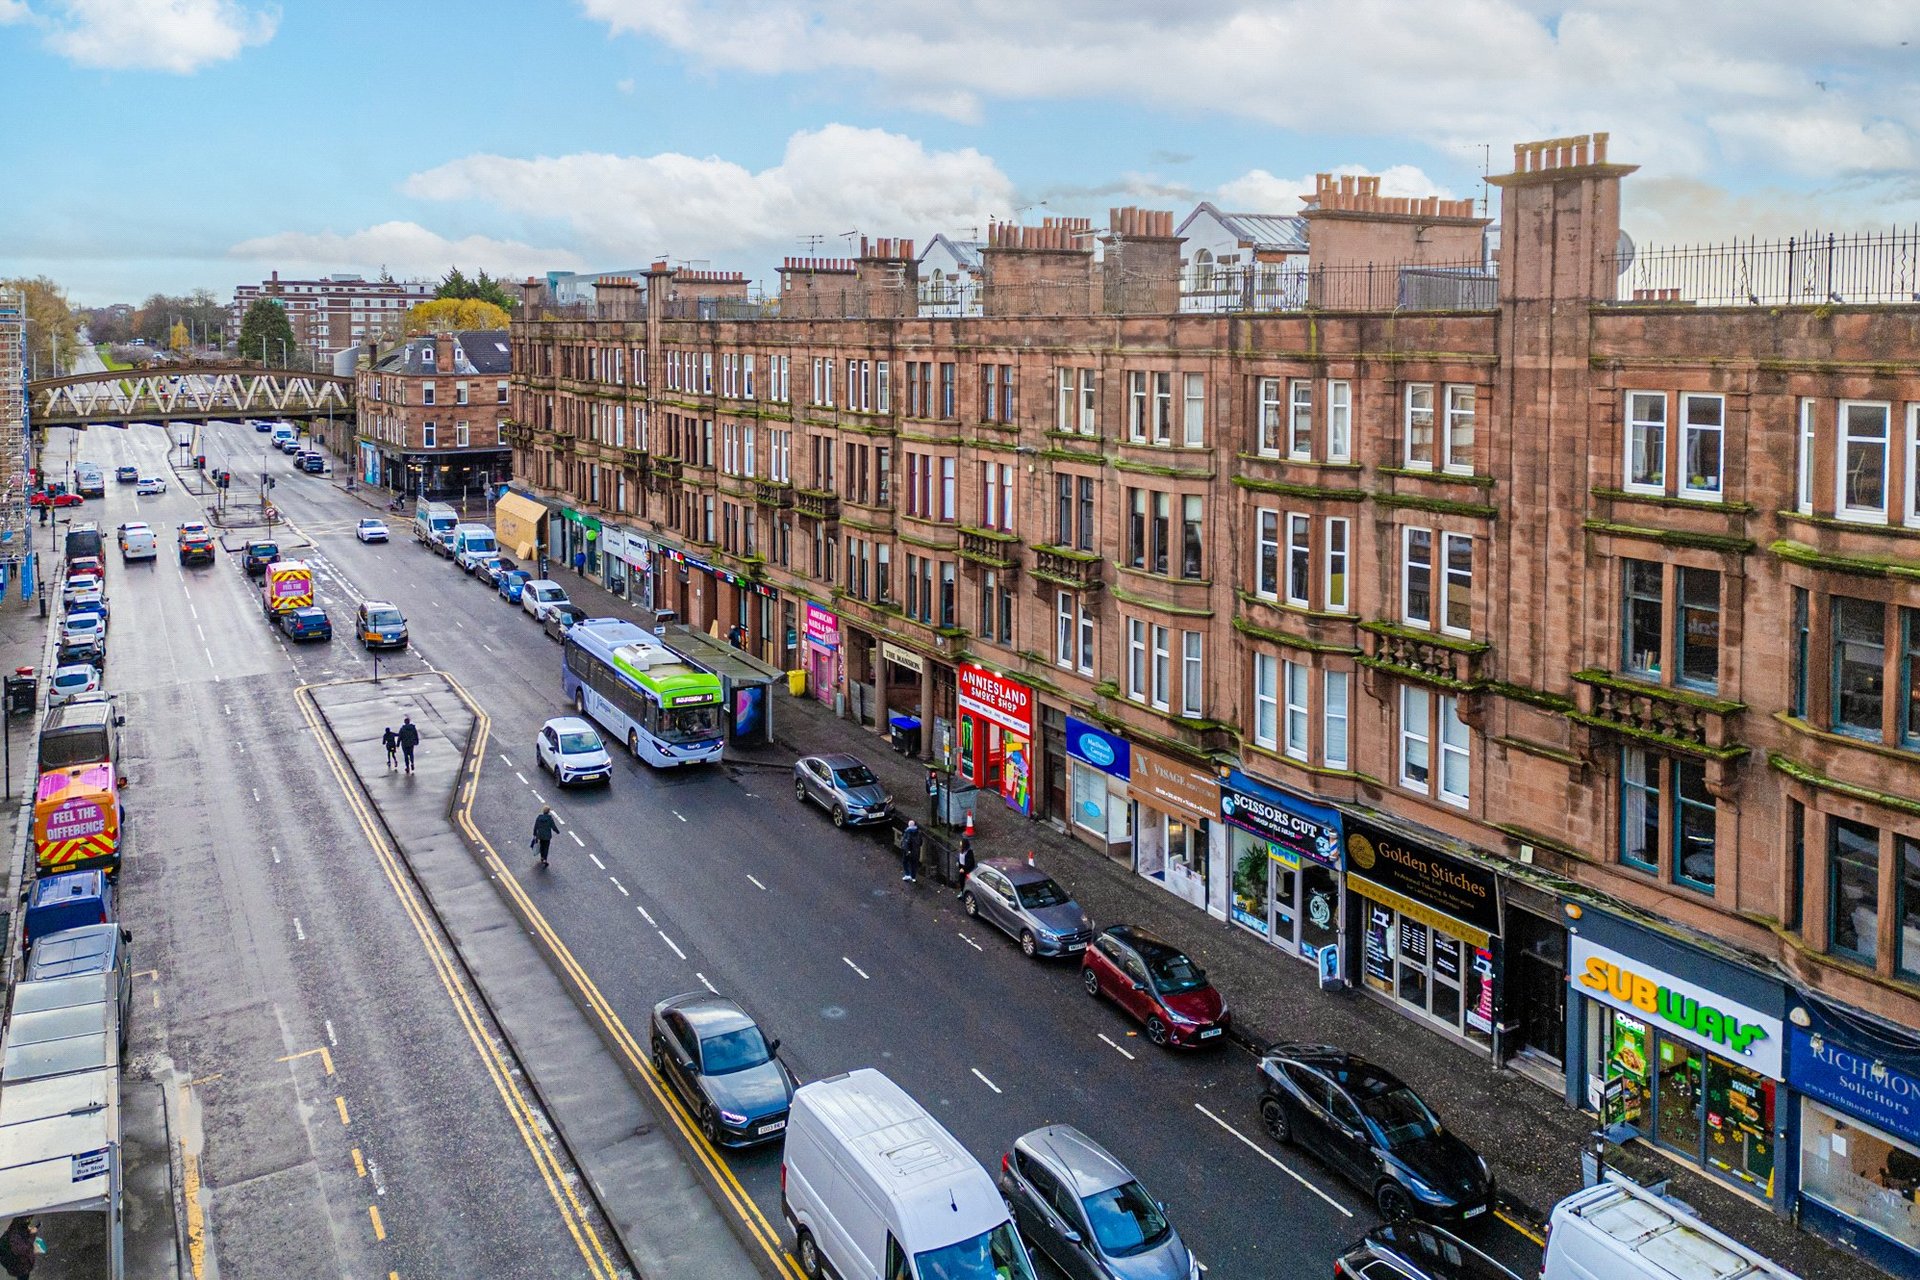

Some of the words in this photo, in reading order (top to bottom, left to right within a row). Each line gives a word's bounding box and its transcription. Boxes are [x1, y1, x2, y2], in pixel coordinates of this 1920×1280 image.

[897, 654, 920, 669] MANSION
[962, 670, 1027, 706] ANNIESLAND
[971, 686, 995, 705] SMOKE
[998, 697, 1018, 713] SHOP
[1153, 763, 1185, 786] VISAGE
[53, 809, 76, 825] FEEL
[77, 806, 96, 820] THE
[1233, 793, 1289, 826] SCISSORS
[1291, 817, 1317, 838] CUT
[47, 819, 105, 841] DIFFERENCE
[1271, 845, 1297, 865] OPEN
[1378, 842, 1428, 873] Golden
[1431, 862, 1486, 898] Stitches
[1578, 956, 1770, 1054] SUBWAY
[1616, 1012, 1646, 1033] Open
[1839, 1075, 1909, 1115] Solicitors
